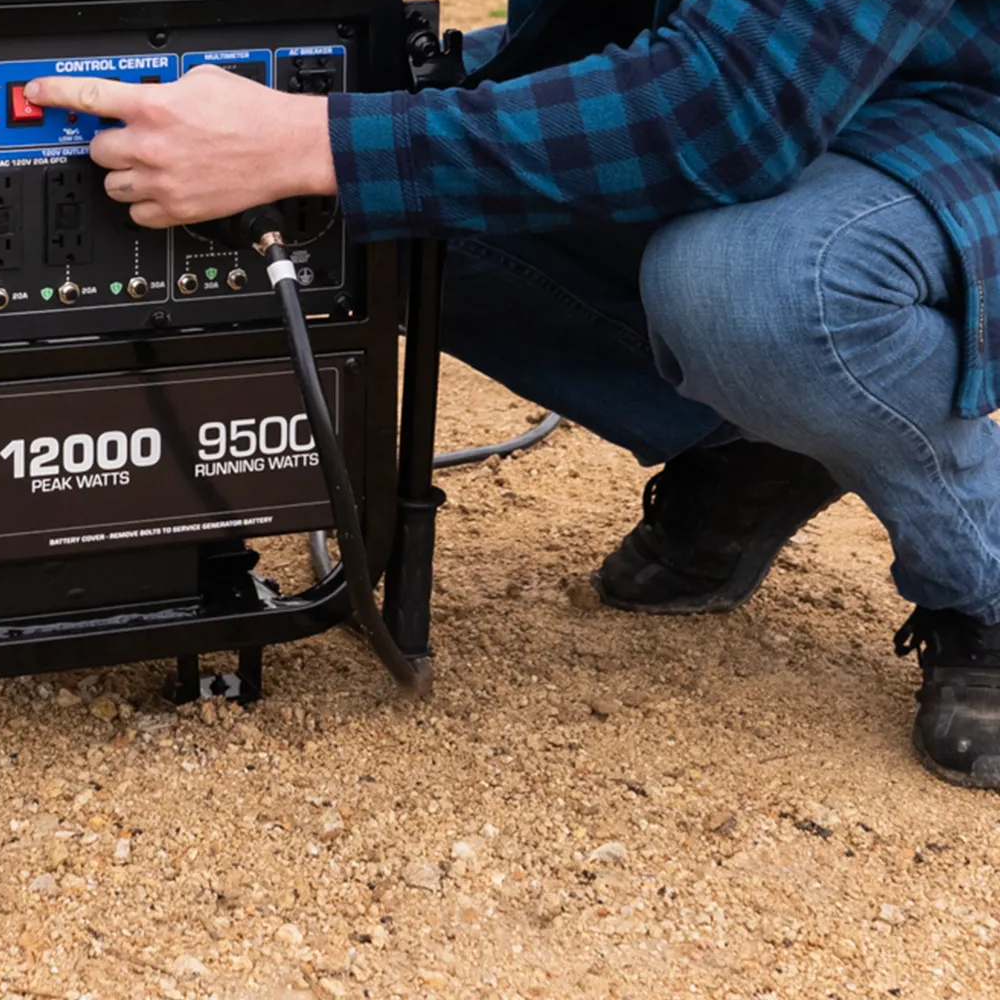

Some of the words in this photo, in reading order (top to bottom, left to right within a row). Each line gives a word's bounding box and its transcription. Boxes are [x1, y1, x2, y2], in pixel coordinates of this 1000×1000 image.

[55, 60, 116, 73] CONTROL
[118, 57, 168, 69] CENTER
[204, 52, 249, 60] MULTIMETER
[0, 427, 161, 478] 12000
[194, 458, 265, 478] RUNNING
[268, 452, 319, 470] WATTS
[31, 475, 72, 493] PEAK
[76, 470, 130, 489] WATTS
[49, 536, 80, 546] BATTERY
[81, 534, 105, 542] COVER
[109, 530, 138, 539] REMOVE
[139, 528, 161, 536] BOLTS
[162, 526, 172, 534] TO
[172, 524, 200, 533] SERVICE
[201, 519, 242, 530] GENERATOR
[243, 516, 273, 525] BATTERY
